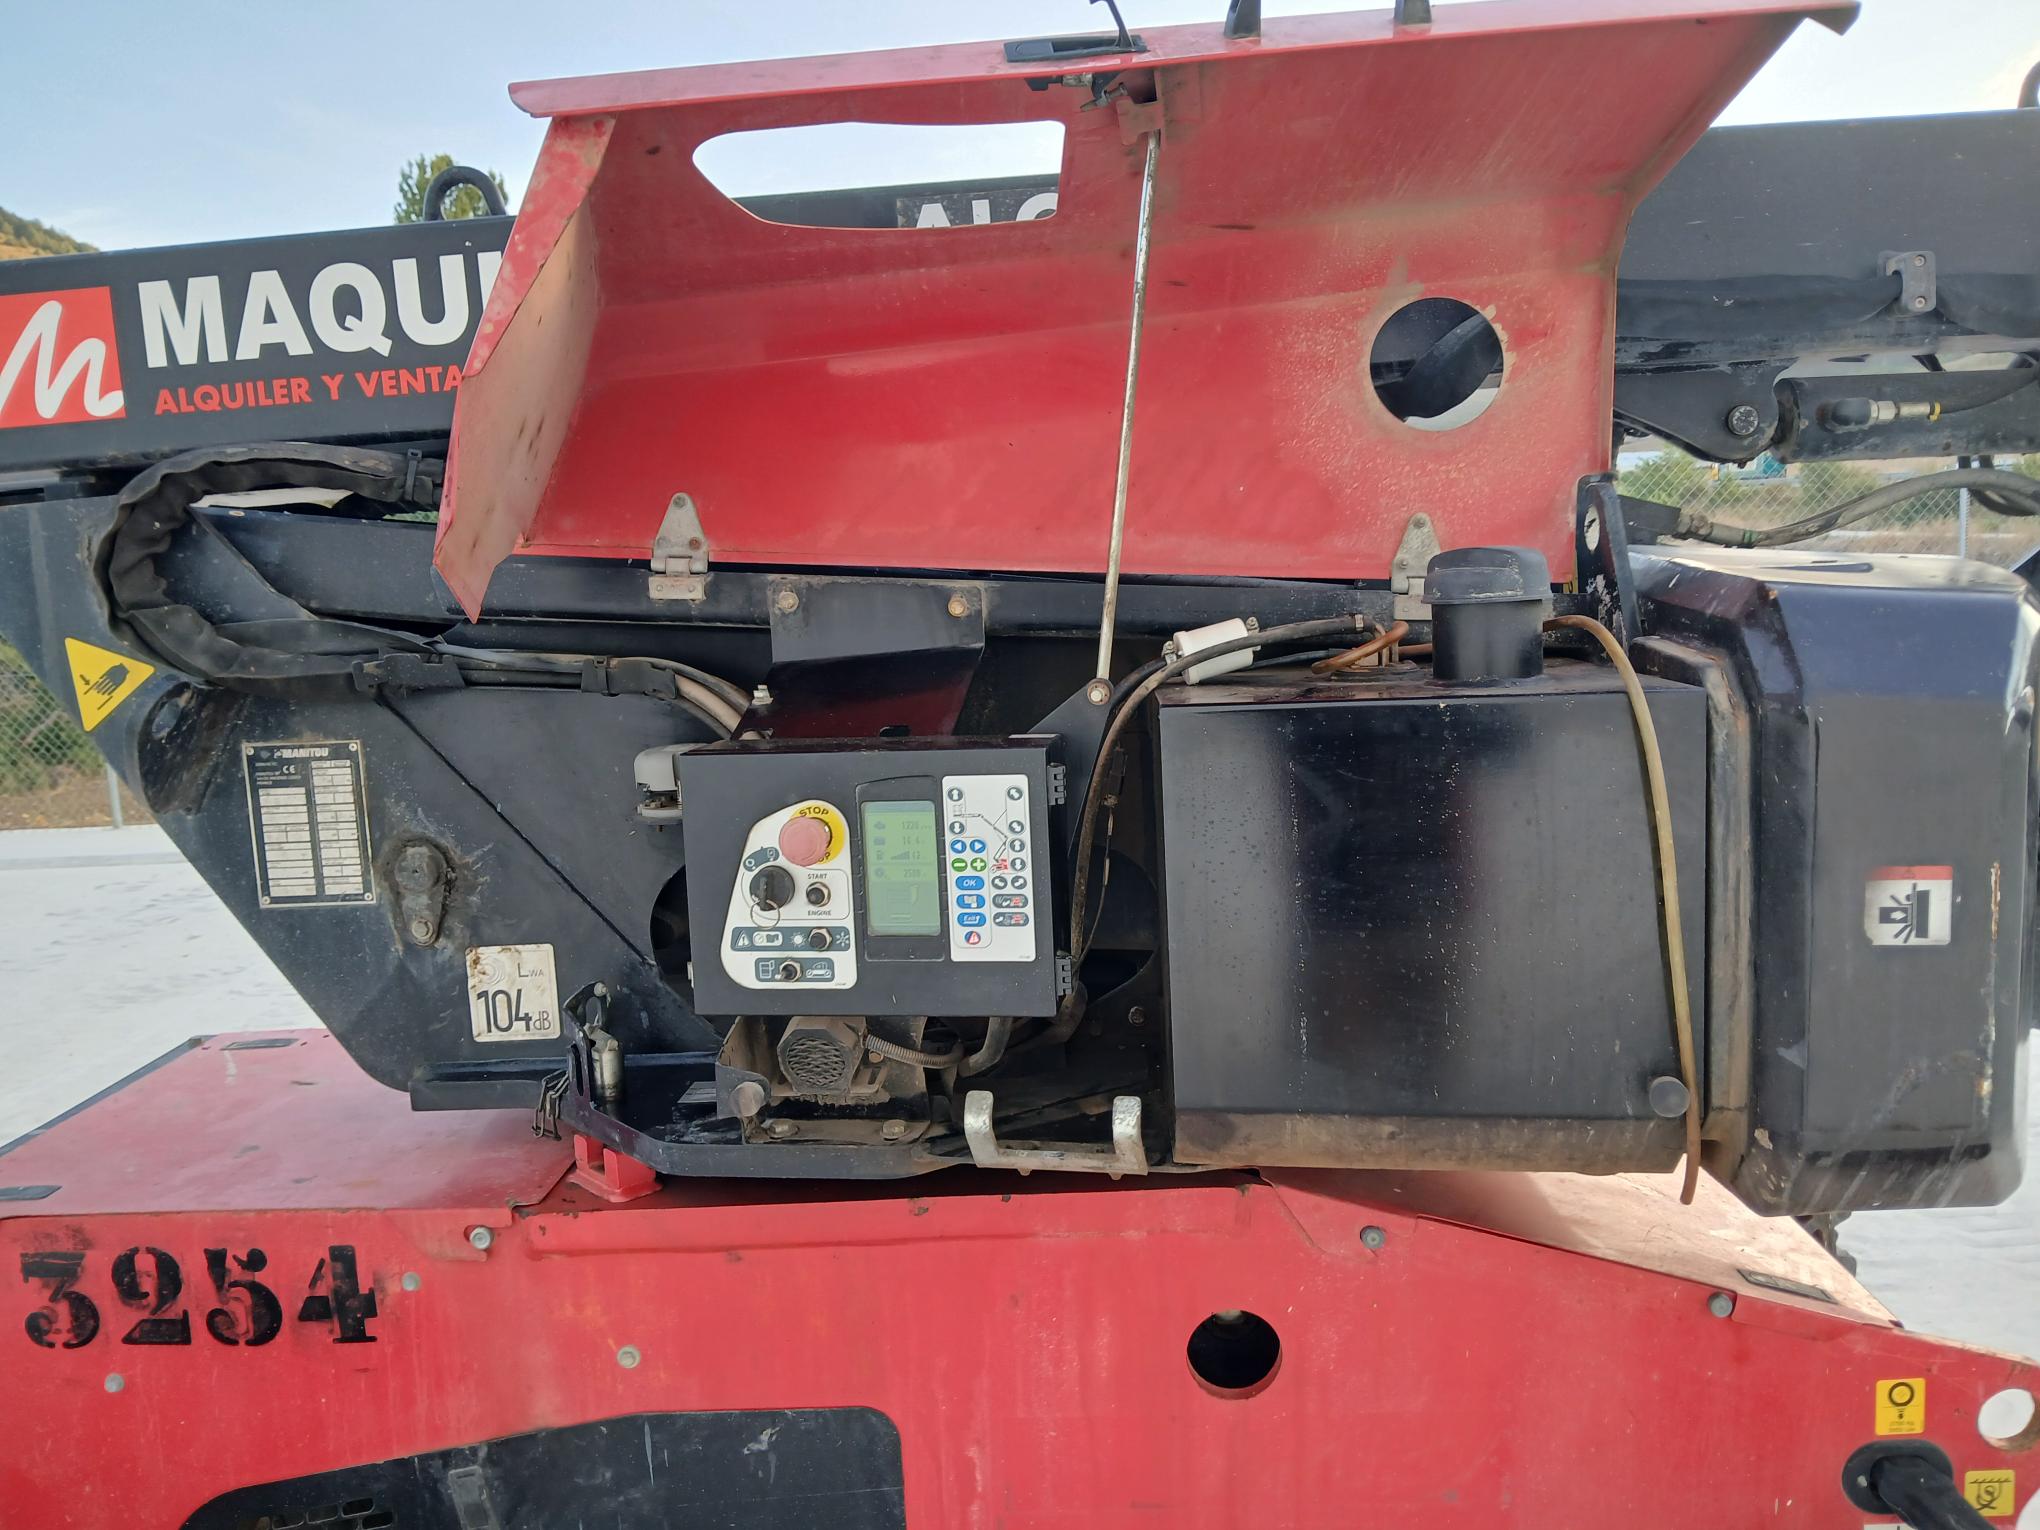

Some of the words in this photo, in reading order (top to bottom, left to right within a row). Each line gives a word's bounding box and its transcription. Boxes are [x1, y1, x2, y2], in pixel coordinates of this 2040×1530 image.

[154, 377, 312, 416] ALQUILER
[321, 374, 345, 400] Y
[354, 364, 465, 398] VENTA
[282, 747, 329, 759] MANITOU
[799, 806, 829, 818] STOP
[963, 879, 977, 887] OK
[20, 1244, 379, 1349] 3254
